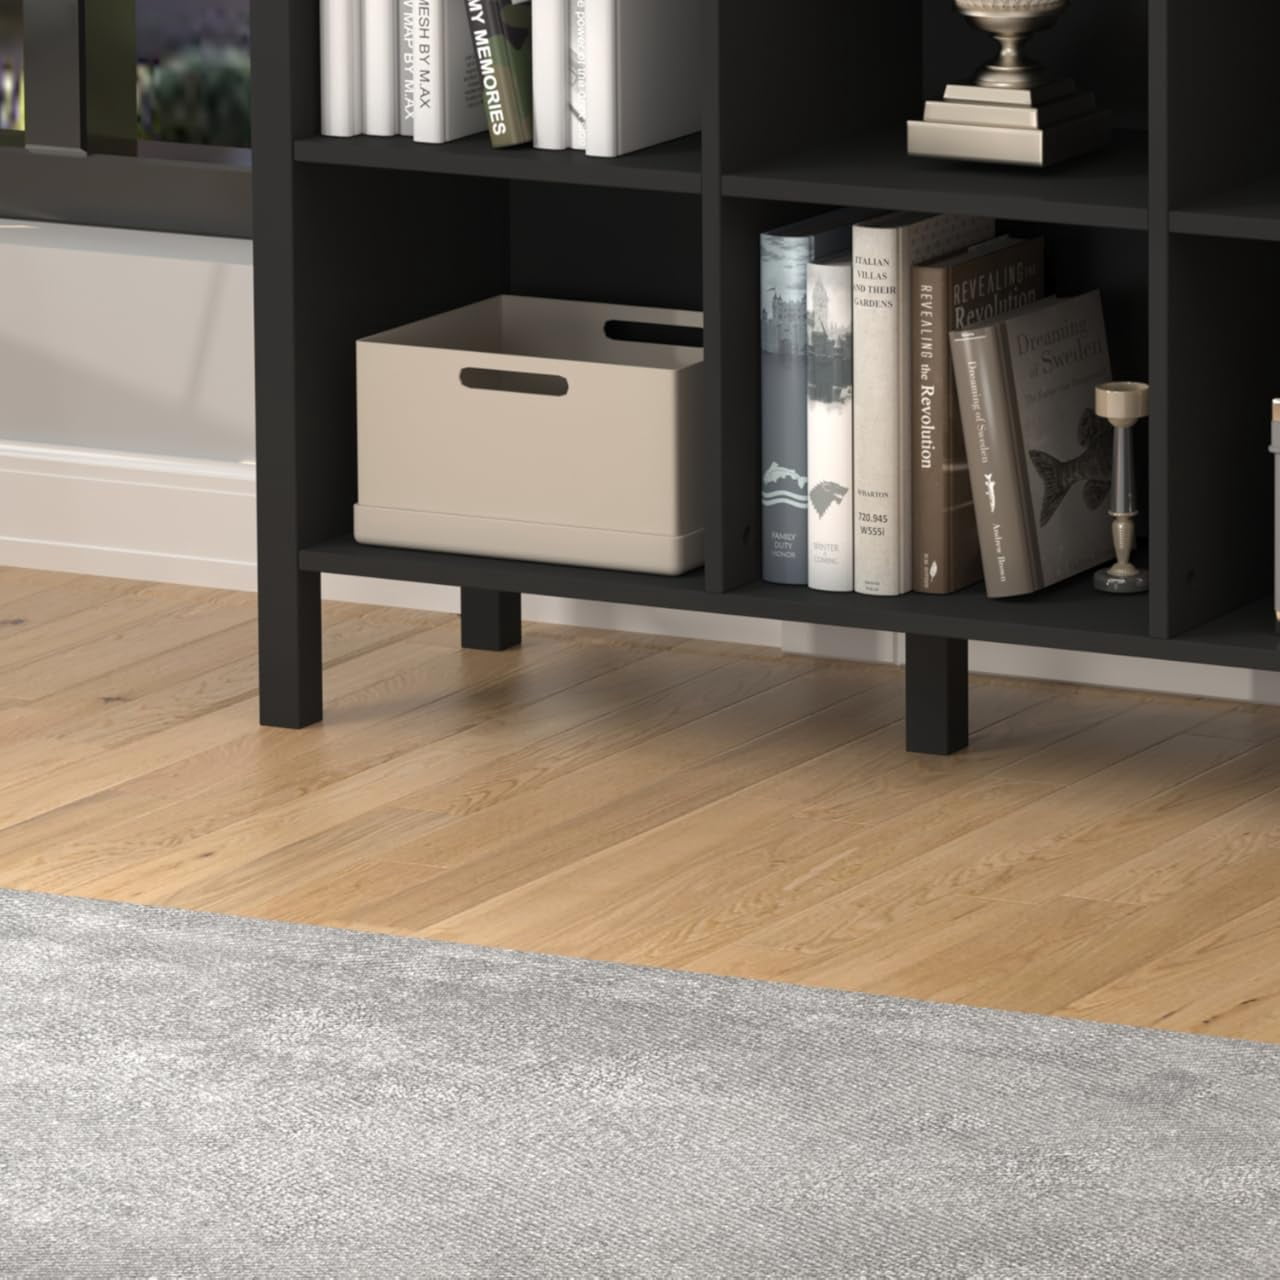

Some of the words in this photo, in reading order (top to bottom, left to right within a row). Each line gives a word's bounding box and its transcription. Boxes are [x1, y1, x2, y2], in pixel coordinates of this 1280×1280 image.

[419, 44, 430, 64] BY
[420, 70, 430, 109] M.AX
[474, 29, 506, 136] MEMORIES
[855, 256, 890, 266] ITALIAN
[857, 270, 888, 280] VILLAS
[868, 286, 896, 295] THEIR
[954, 261, 1024, 307] REVEALING
[854, 297, 894, 308] GARDENS
[920, 285, 933, 358] REVEALING
[1016, 318, 1089, 356] Dreaming
[920, 364, 931, 381] the
[1040, 339, 1104, 374] Sweden
[966, 361, 984, 410] Dreaming
[920, 385, 936, 469] Revolution
[974, 412, 986, 422] of
[976, 424, 990, 463] Sweden
[774, 542, 793, 550] DUTY
